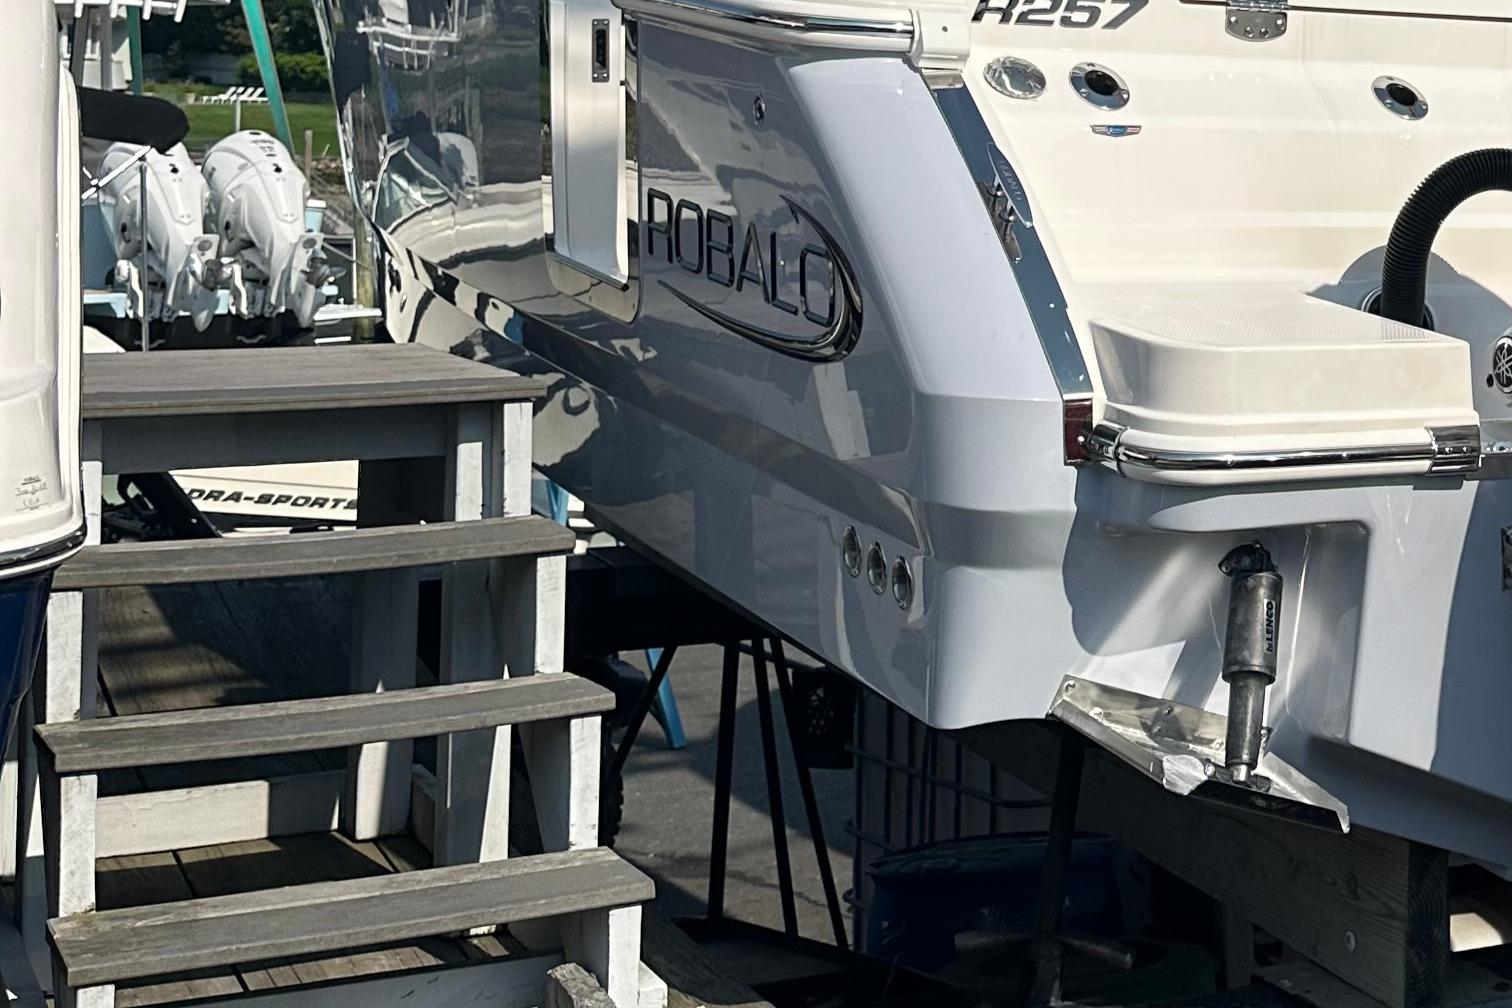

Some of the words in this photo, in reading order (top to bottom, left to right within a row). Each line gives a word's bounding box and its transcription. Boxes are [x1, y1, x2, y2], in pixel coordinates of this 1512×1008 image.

[648, 188, 835, 328] ROBALO
[187, 488, 358, 510] DRA-SPORTS
[1265, 600, 1275, 643] LENCO
